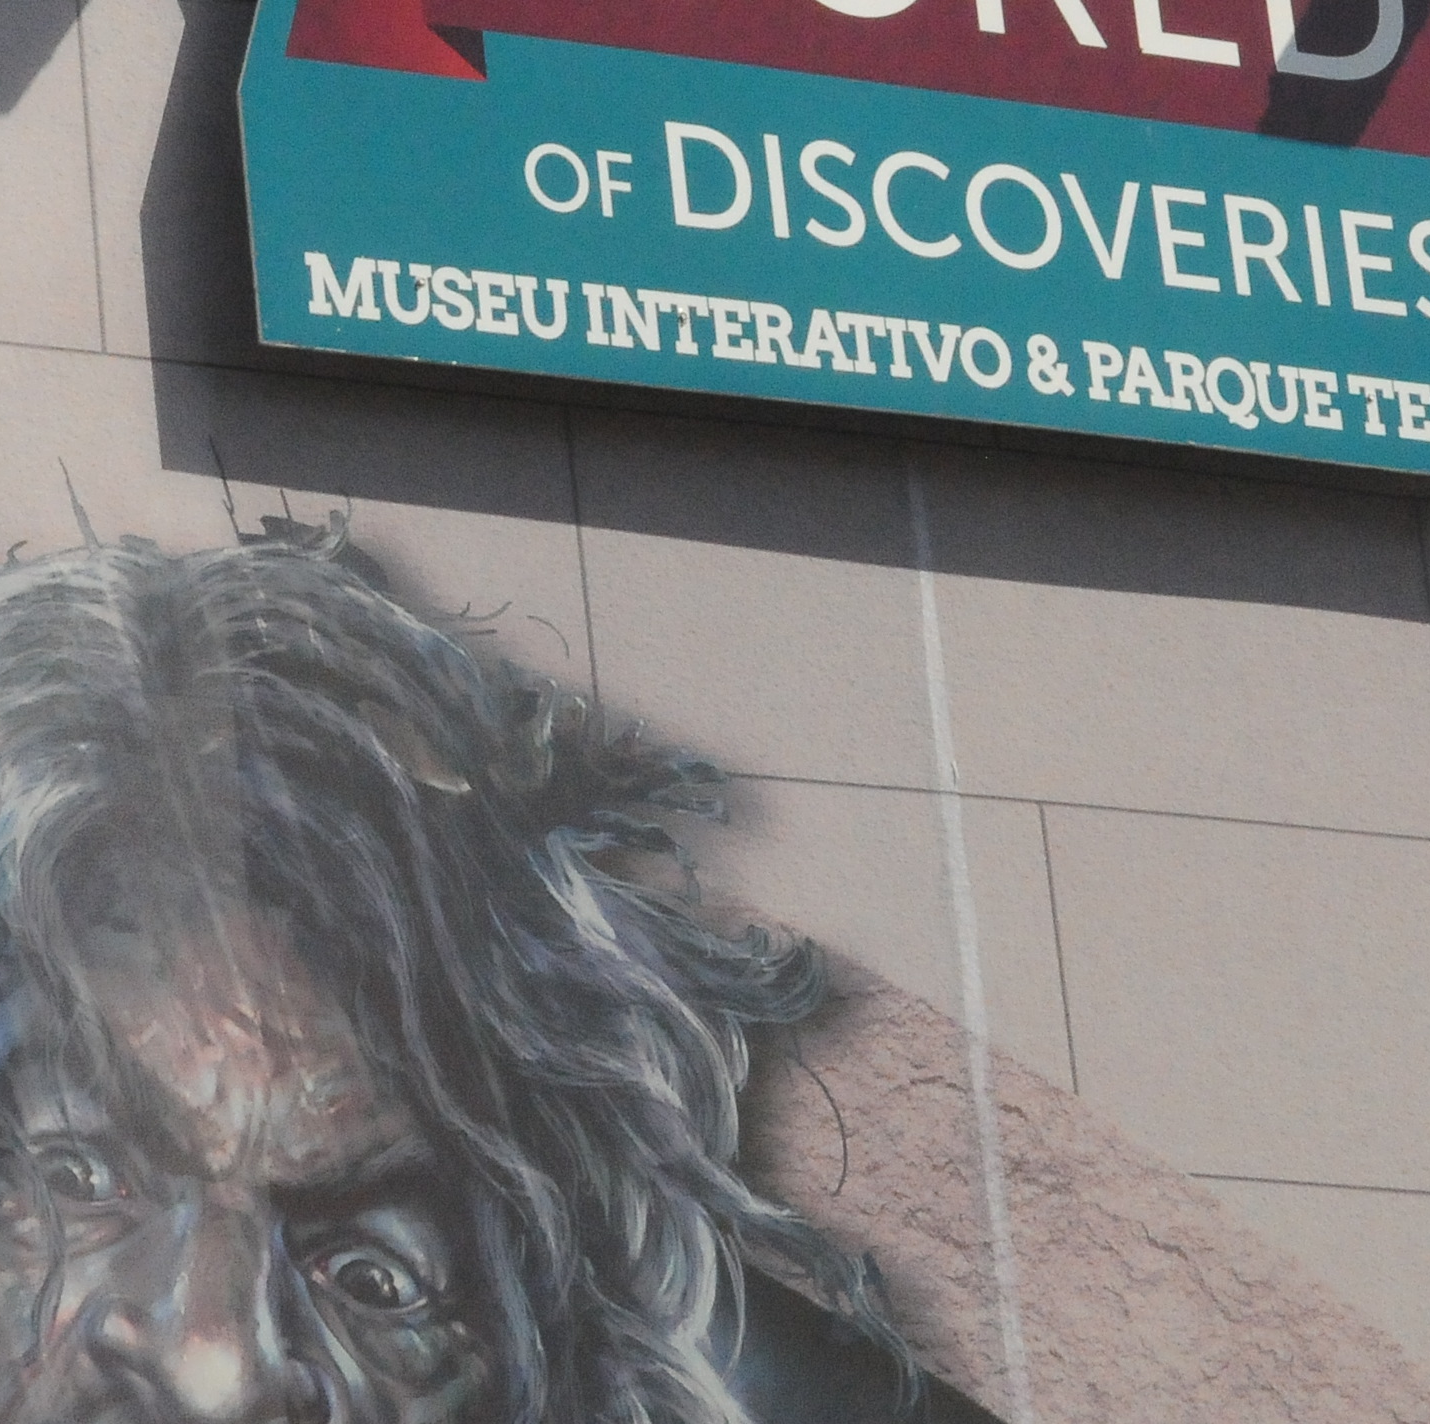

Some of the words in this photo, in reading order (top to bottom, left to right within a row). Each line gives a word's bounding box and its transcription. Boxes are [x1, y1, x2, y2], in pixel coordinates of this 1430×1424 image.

[524, 143, 633, 217] OF
[304, 251, 570, 340] MUSEU
[581, 282, 1012, 389] INTERATIVO
[1026, 333, 1075, 397] &
[1082, 340, 1344, 431] PARQUE
